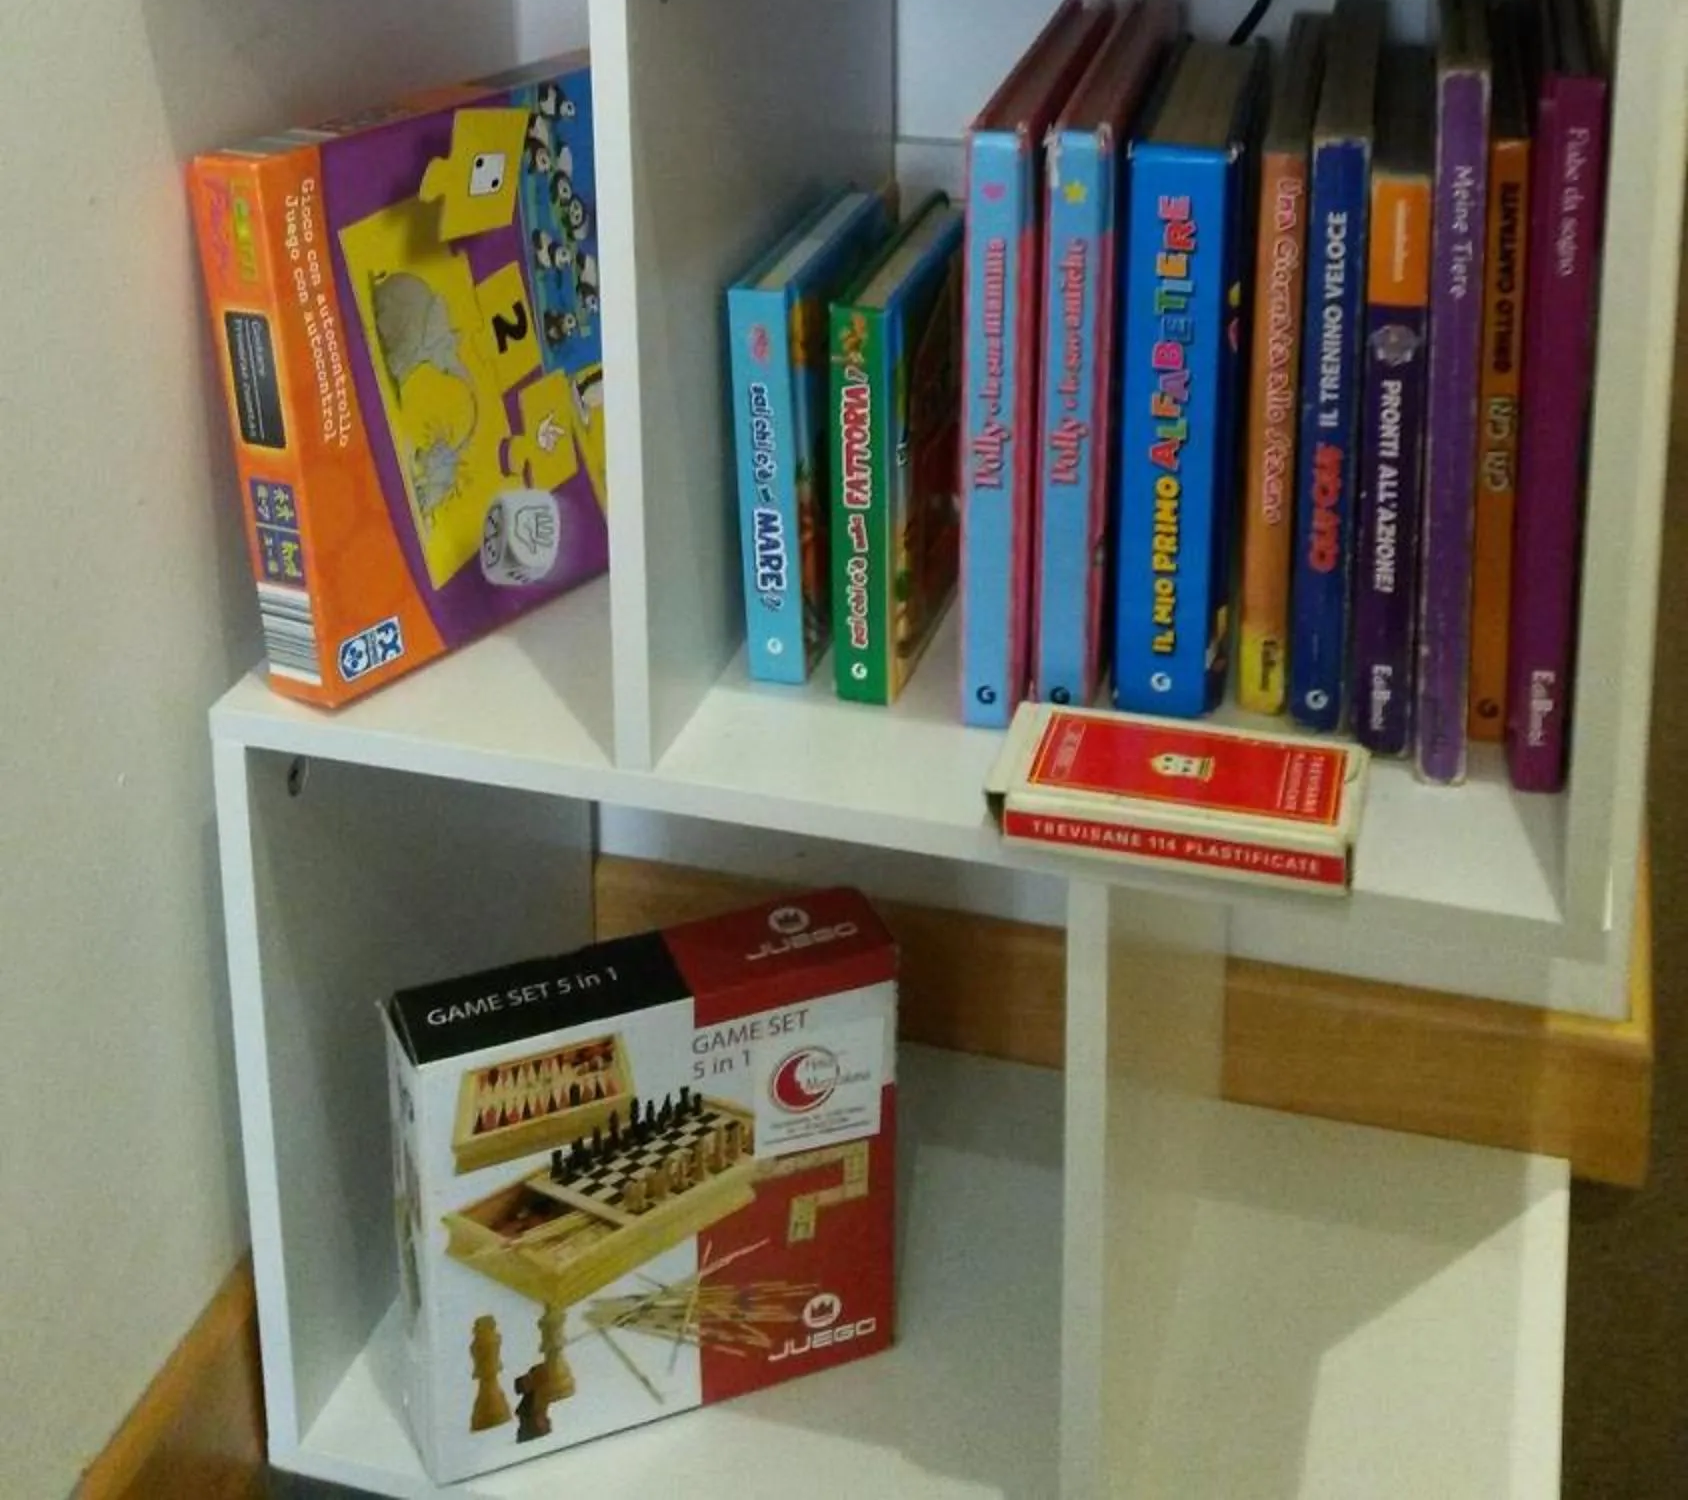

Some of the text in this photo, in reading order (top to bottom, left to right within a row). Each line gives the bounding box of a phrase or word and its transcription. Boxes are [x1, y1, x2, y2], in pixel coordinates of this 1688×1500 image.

[1448, 164, 1474, 301] Meine Tiere
[1553, 126, 1589, 278] Fiabe da sogno
[285, 194, 338, 444] Juego con autocontrol
[301, 177, 351, 449] Gioco con autocontrollo
[1317, 210, 1348, 429] IL TRENINO VELOCE
[972, 418, 1010, 490] Polly
[1050, 416, 1087, 486] Polly
[1148, 195, 1198, 655] IL MIO PRIMO ALFABETIERE
[1373, 379, 1403, 594] PRONTI ALL'AZIONE!
[1031, 818, 1142, 848] TREVISANE
[1184, 839, 1322, 875] PLASTIFICATE
[746, 923, 857, 960] JUEGO
[427, 965, 618, 1027] GAME SET 5 in 1
[690, 1008, 810, 1057] GAME SET
[692, 1048, 753, 1080] 5 in 1
[768, 1317, 877, 1363] JUEGO
